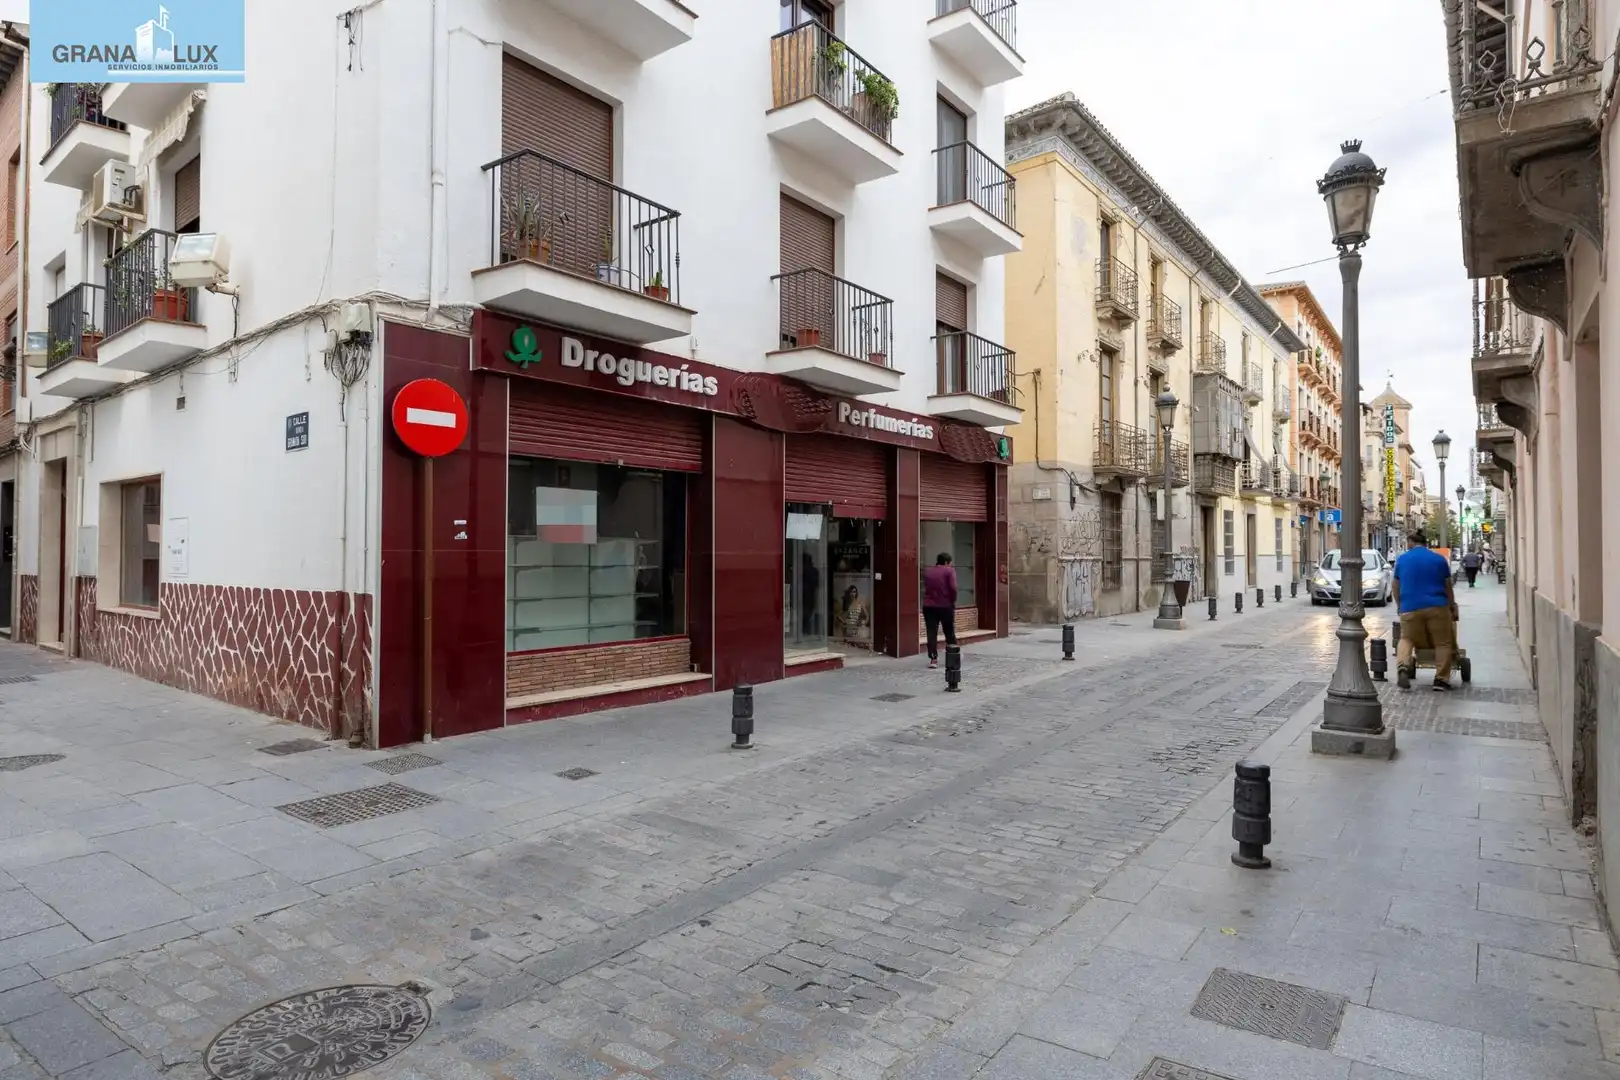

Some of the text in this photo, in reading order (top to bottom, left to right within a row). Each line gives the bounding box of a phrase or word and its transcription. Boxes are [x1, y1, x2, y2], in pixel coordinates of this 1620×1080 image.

[560, 336, 719, 396] Droguerías
[292, 415, 307, 426] CALLE
[838, 401, 934, 440] Perfumerías
[1386, 404, 1394, 443] TEJIDOS
